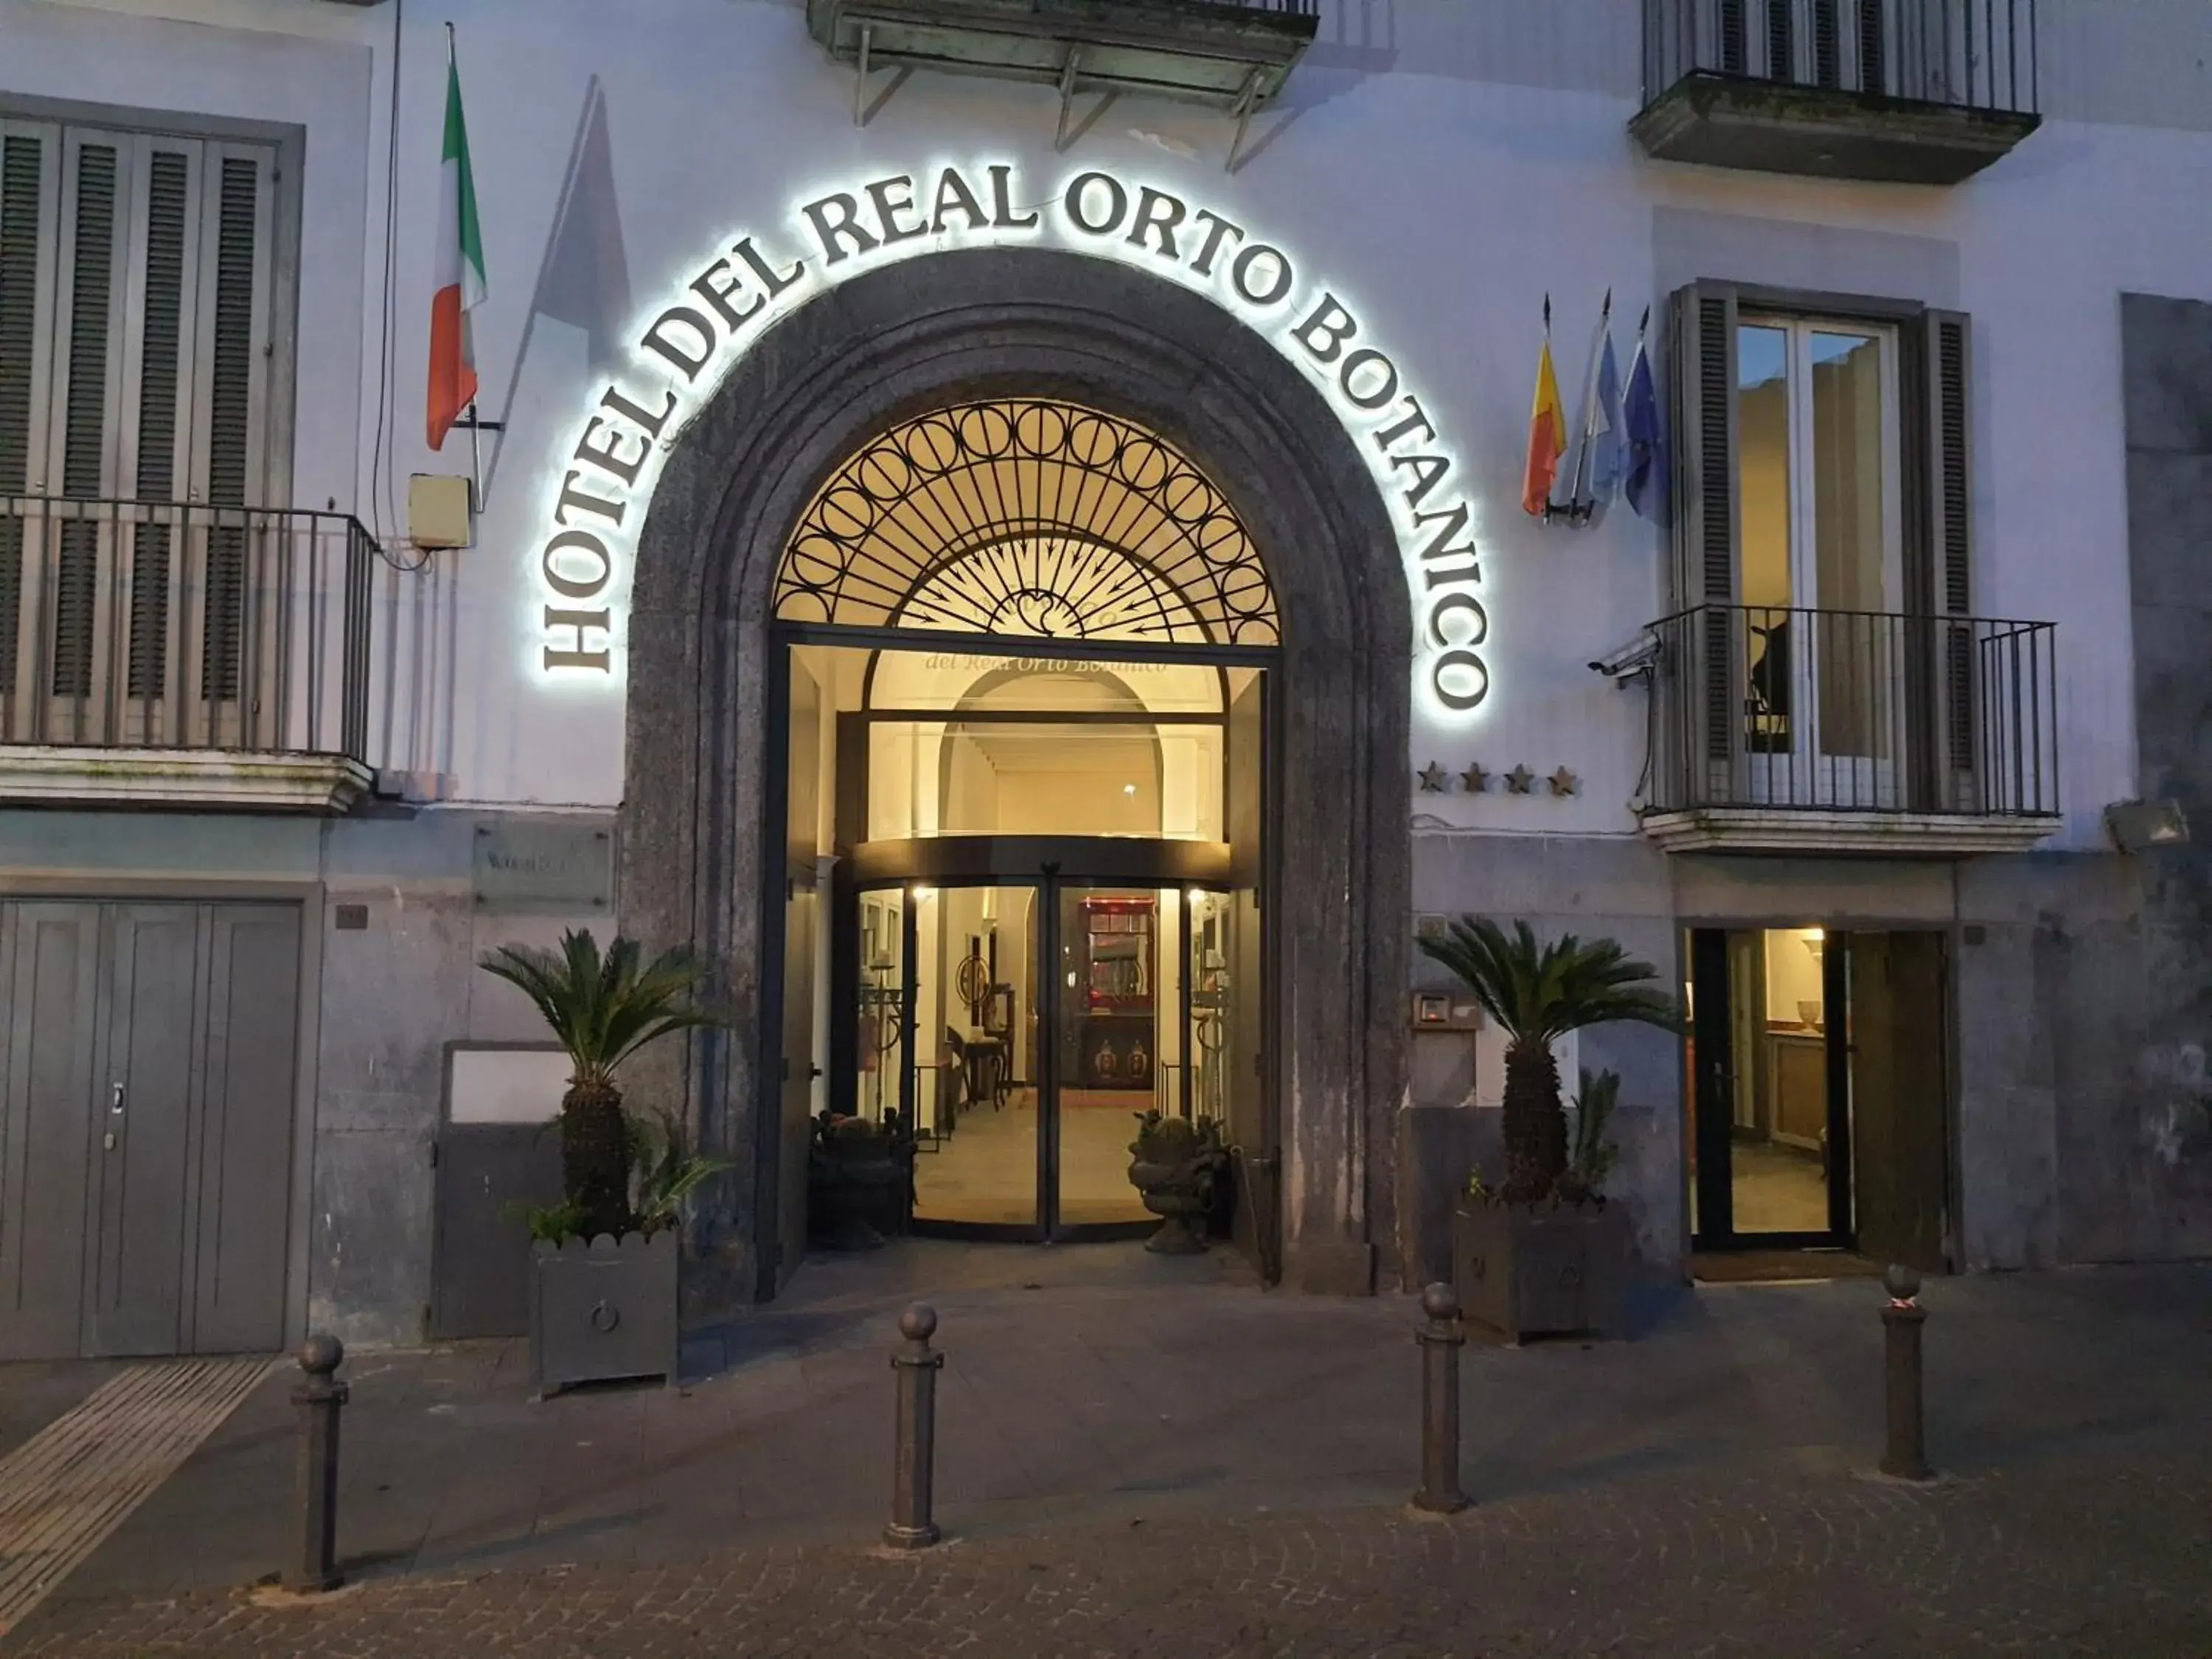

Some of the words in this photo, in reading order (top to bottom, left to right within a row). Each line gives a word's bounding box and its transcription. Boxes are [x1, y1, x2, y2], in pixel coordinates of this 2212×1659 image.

[543, 386, 676, 674] HOTEL
[641, 237, 804, 383] DEL
[802, 166, 1038, 266] REAL
[1065, 172, 1293, 305] ORTO
[1291, 293, 1489, 710] BOTANICO
[925, 652, 956, 669] del
[1018, 657, 1068, 672] Orto
